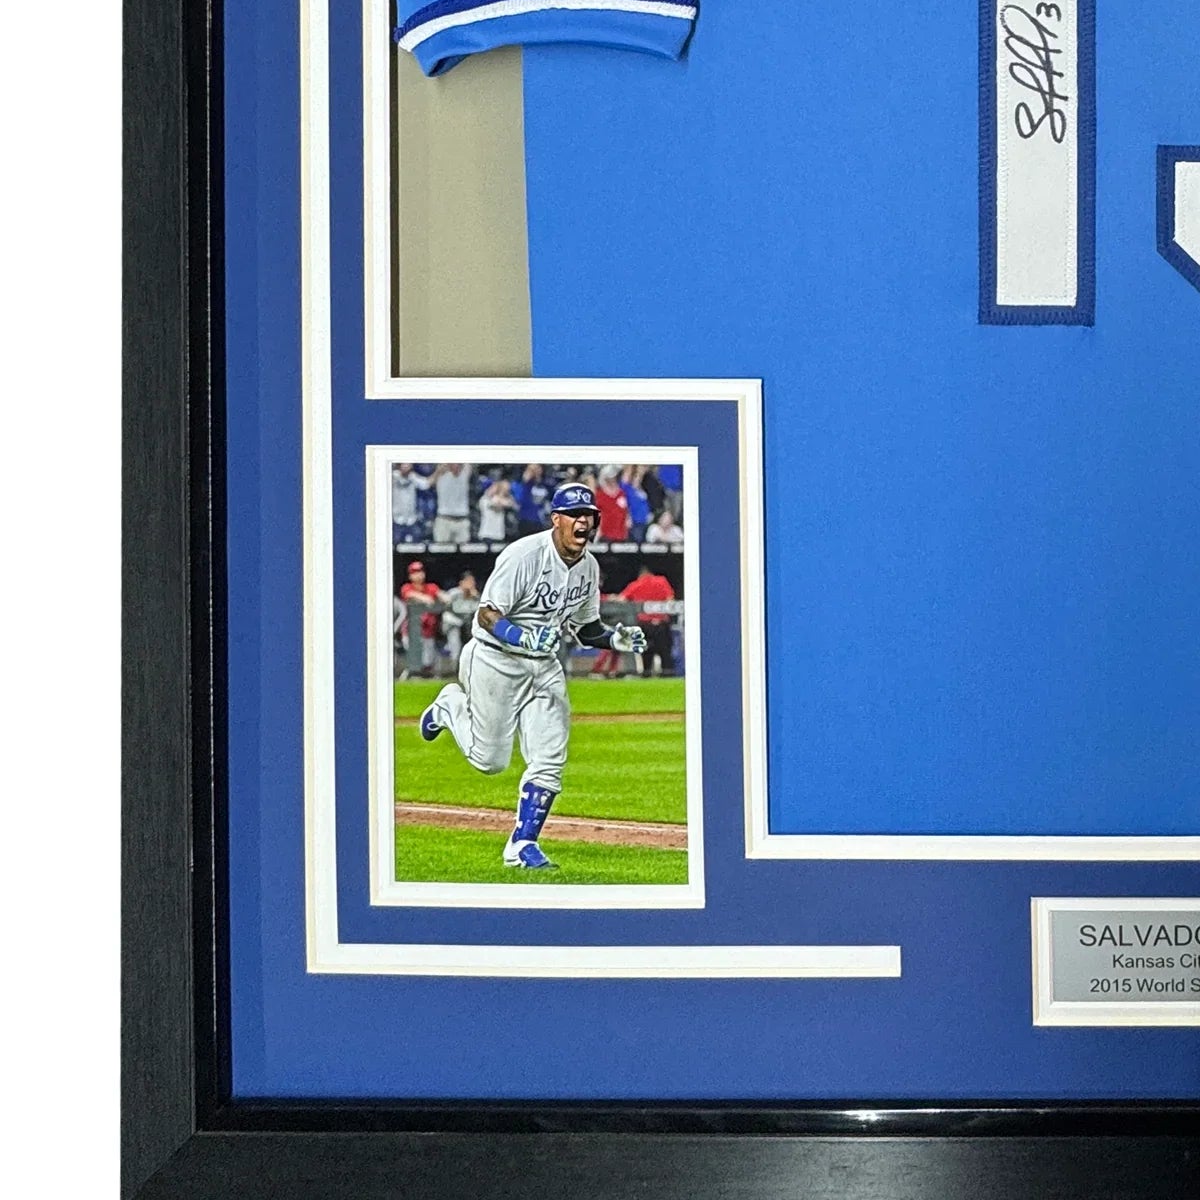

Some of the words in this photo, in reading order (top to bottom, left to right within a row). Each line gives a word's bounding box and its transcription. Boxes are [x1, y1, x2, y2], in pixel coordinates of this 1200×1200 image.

[529, 574, 592, 616] Royals
[1112, 954, 1175, 969] Kansas
[1090, 978, 1132, 993] 2015
[1136, 978, 1185, 993] World
